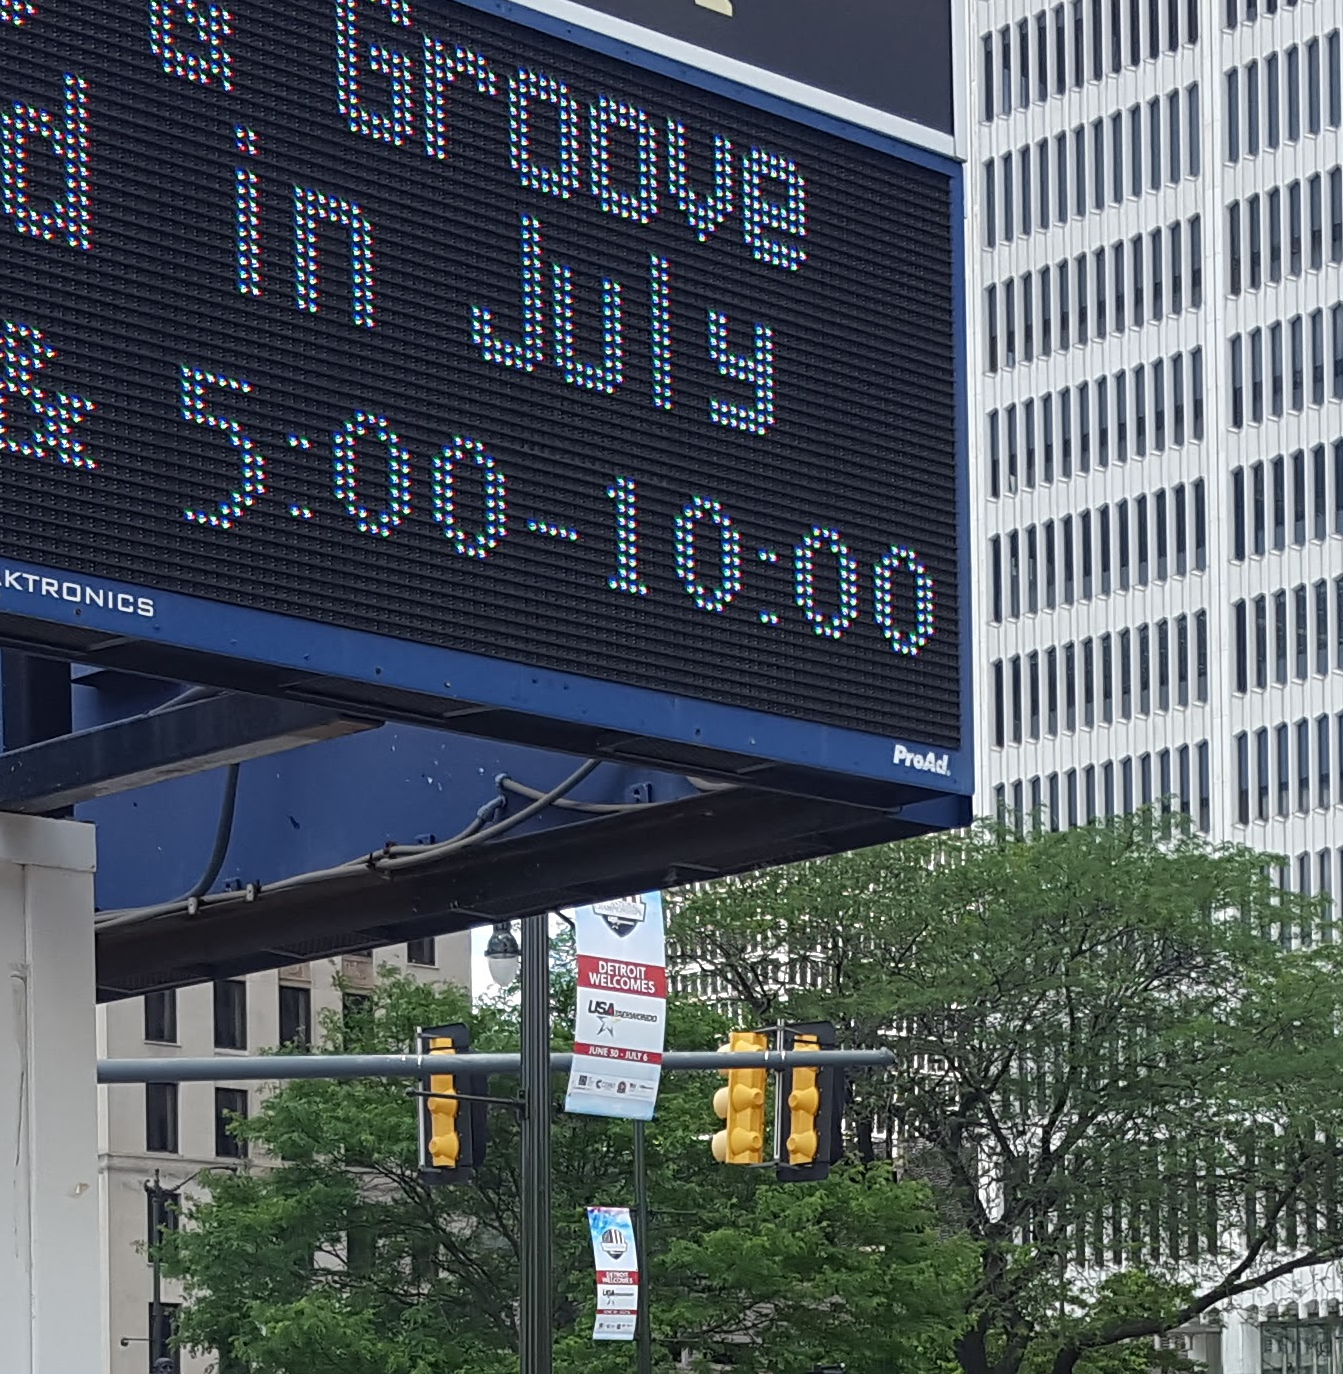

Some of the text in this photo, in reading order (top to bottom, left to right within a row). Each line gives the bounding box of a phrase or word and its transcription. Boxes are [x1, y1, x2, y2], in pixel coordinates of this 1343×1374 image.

[337, 0, 807, 270] Groove
[236, 127, 375, 327] in
[473, 216, 775, 434] July
[182, 367, 933, 655] 5:00-10:00
[598, 961, 647, 979] DETROIT
[588, 972, 656, 994] WELCOMES
[588, 999, 615, 1016] USA
[588, 1046, 608, 1056] JUNE
[610, 1048, 619, 1058] 30
[625, 1051, 642, 1061] JULY
[642, 1053, 648, 1062] 6
